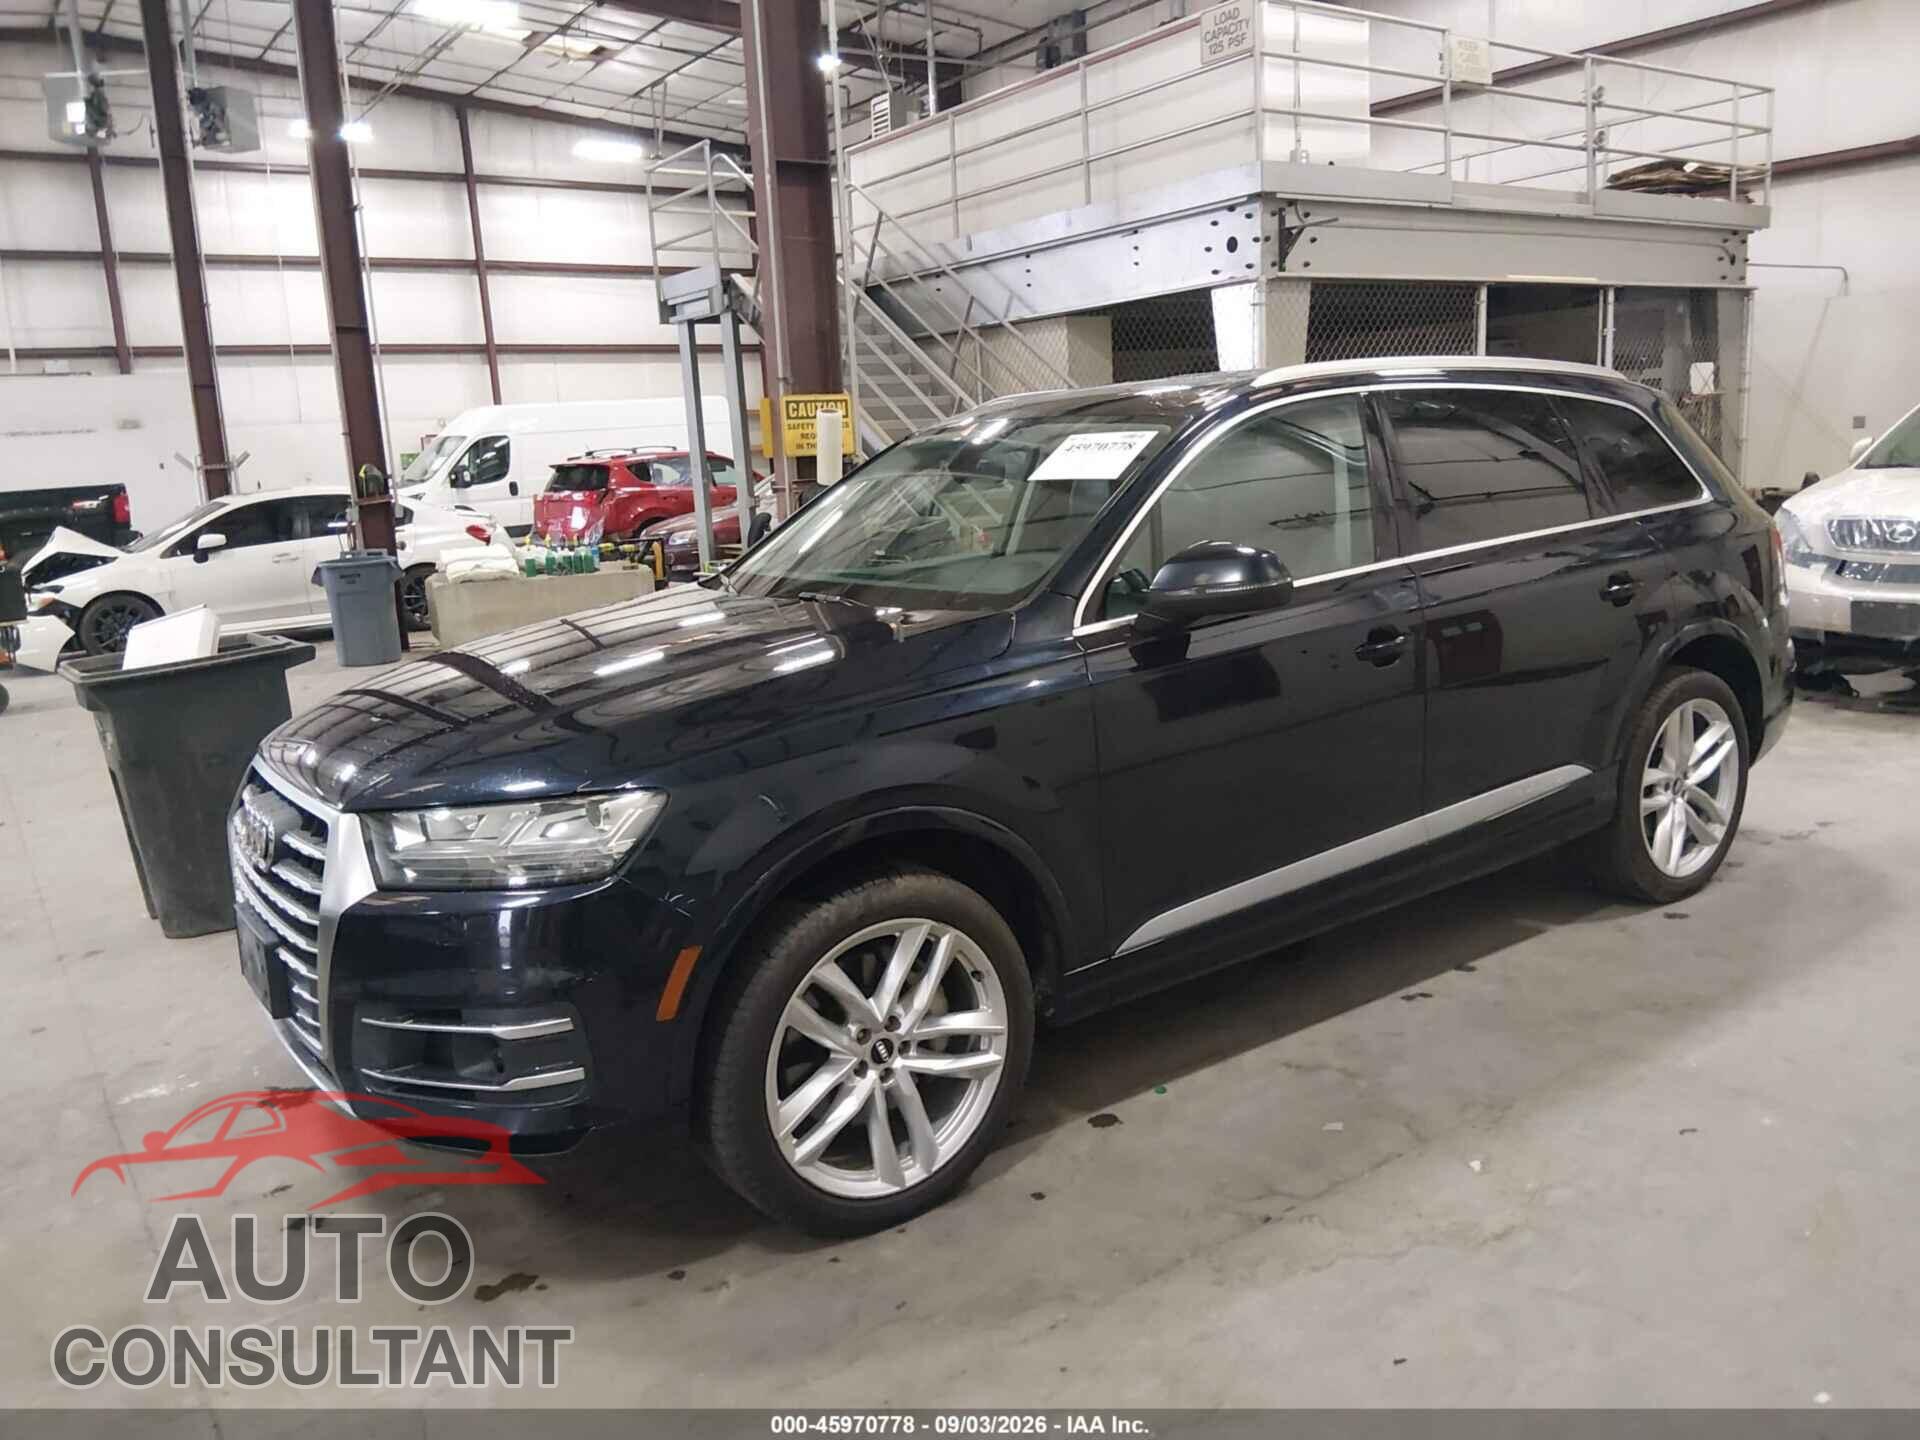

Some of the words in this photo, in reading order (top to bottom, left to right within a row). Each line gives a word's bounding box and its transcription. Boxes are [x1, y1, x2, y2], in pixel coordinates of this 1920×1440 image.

[1213, 7, 1240, 26] LOAD
[1204, 17, 1250, 43] CAPACITY
[1208, 40, 1225, 56] 125
[1227, 31, 1248, 48] PSF
[788, 401, 847, 418] CAUTION
[787, 422, 815, 430] SAFETY
